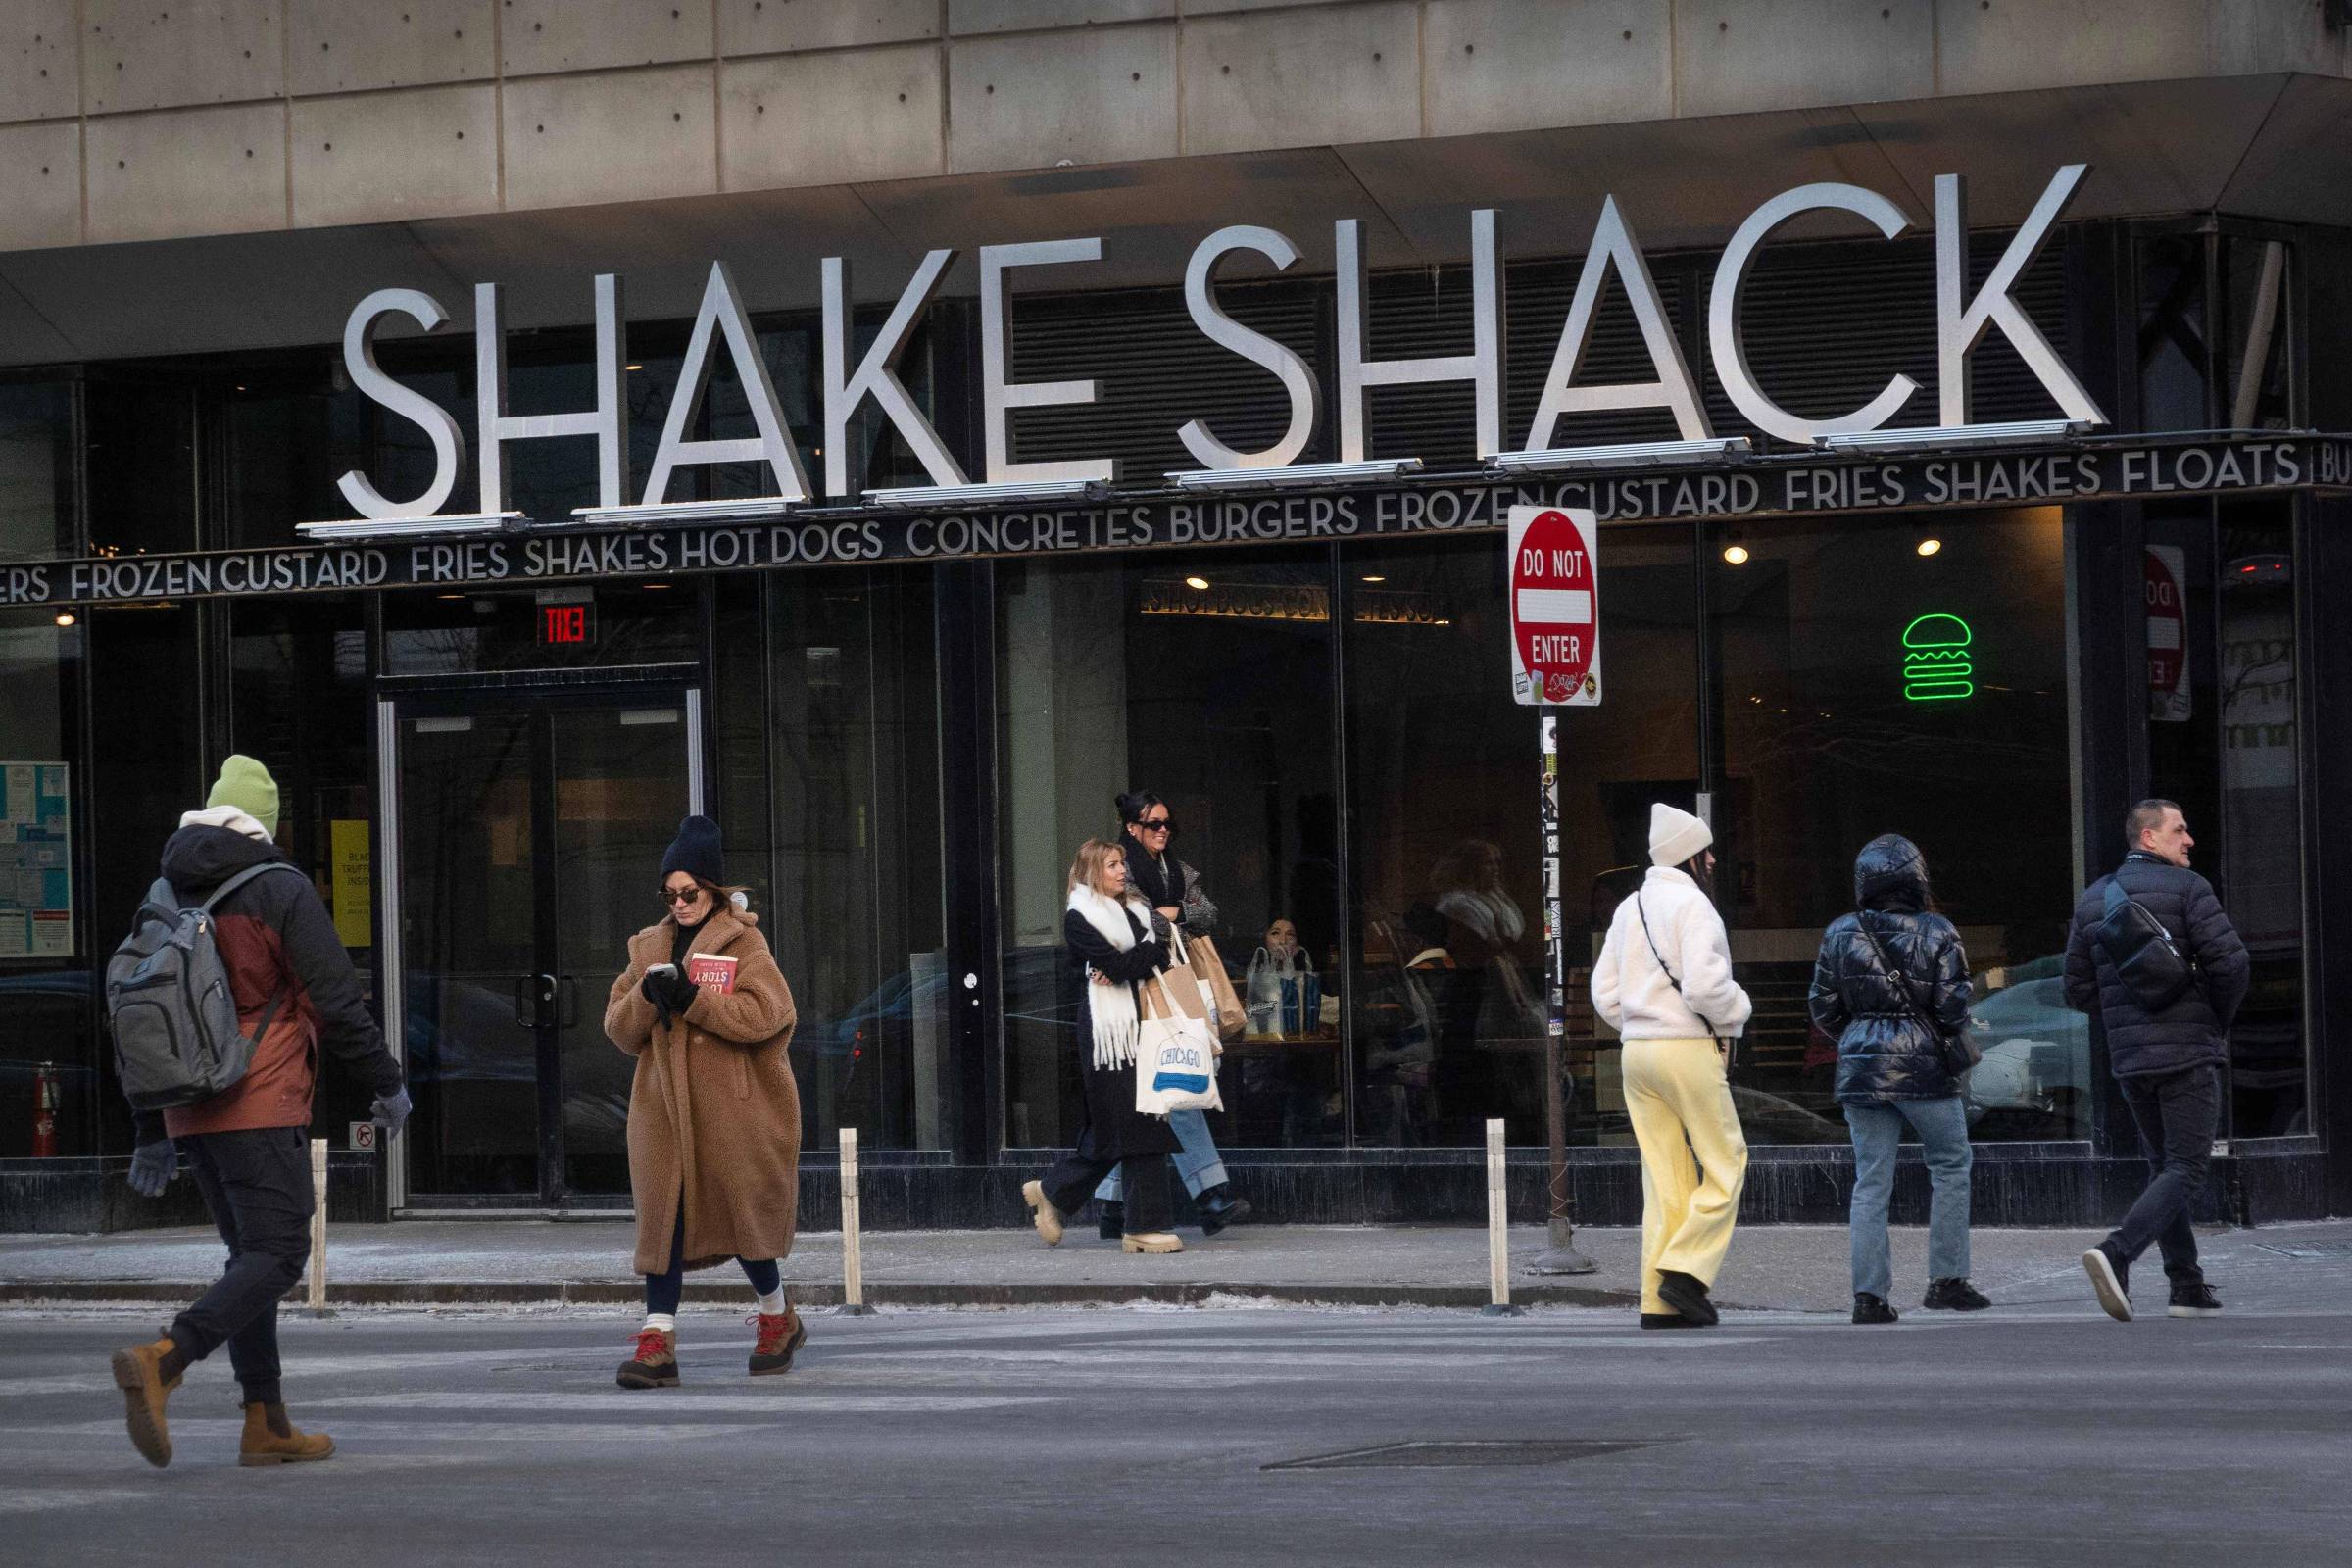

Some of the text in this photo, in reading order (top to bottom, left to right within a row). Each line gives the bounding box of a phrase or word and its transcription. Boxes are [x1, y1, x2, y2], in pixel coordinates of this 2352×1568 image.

[336, 164, 2109, 518] SHAKE SHACK
[71, 558, 212, 599] FROZEN
[220, 549, 387, 592] CUSTARD
[412, 542, 509, 582] FRIES
[524, 532, 668, 576] SHAKES
[681, 527, 764, 568] HOT
[771, 522, 883, 564] DOGS
[906, 507, 1153, 557] CONCRETES
[1170, 497, 1359, 543] BURGERS
[1555, 475, 1759, 520] CUSTARD
[1786, 464, 1905, 511] FRIES
[1925, 454, 2101, 504] SHAKES
[2122, 443, 2300, 492] FLOATS
[1523, 549, 1584, 579] DO NOT
[1532, 635, 1581, 663] ENTER
[695, 971, 728, 982] STORY
[1161, 1048, 1200, 1068] CHICAGO
